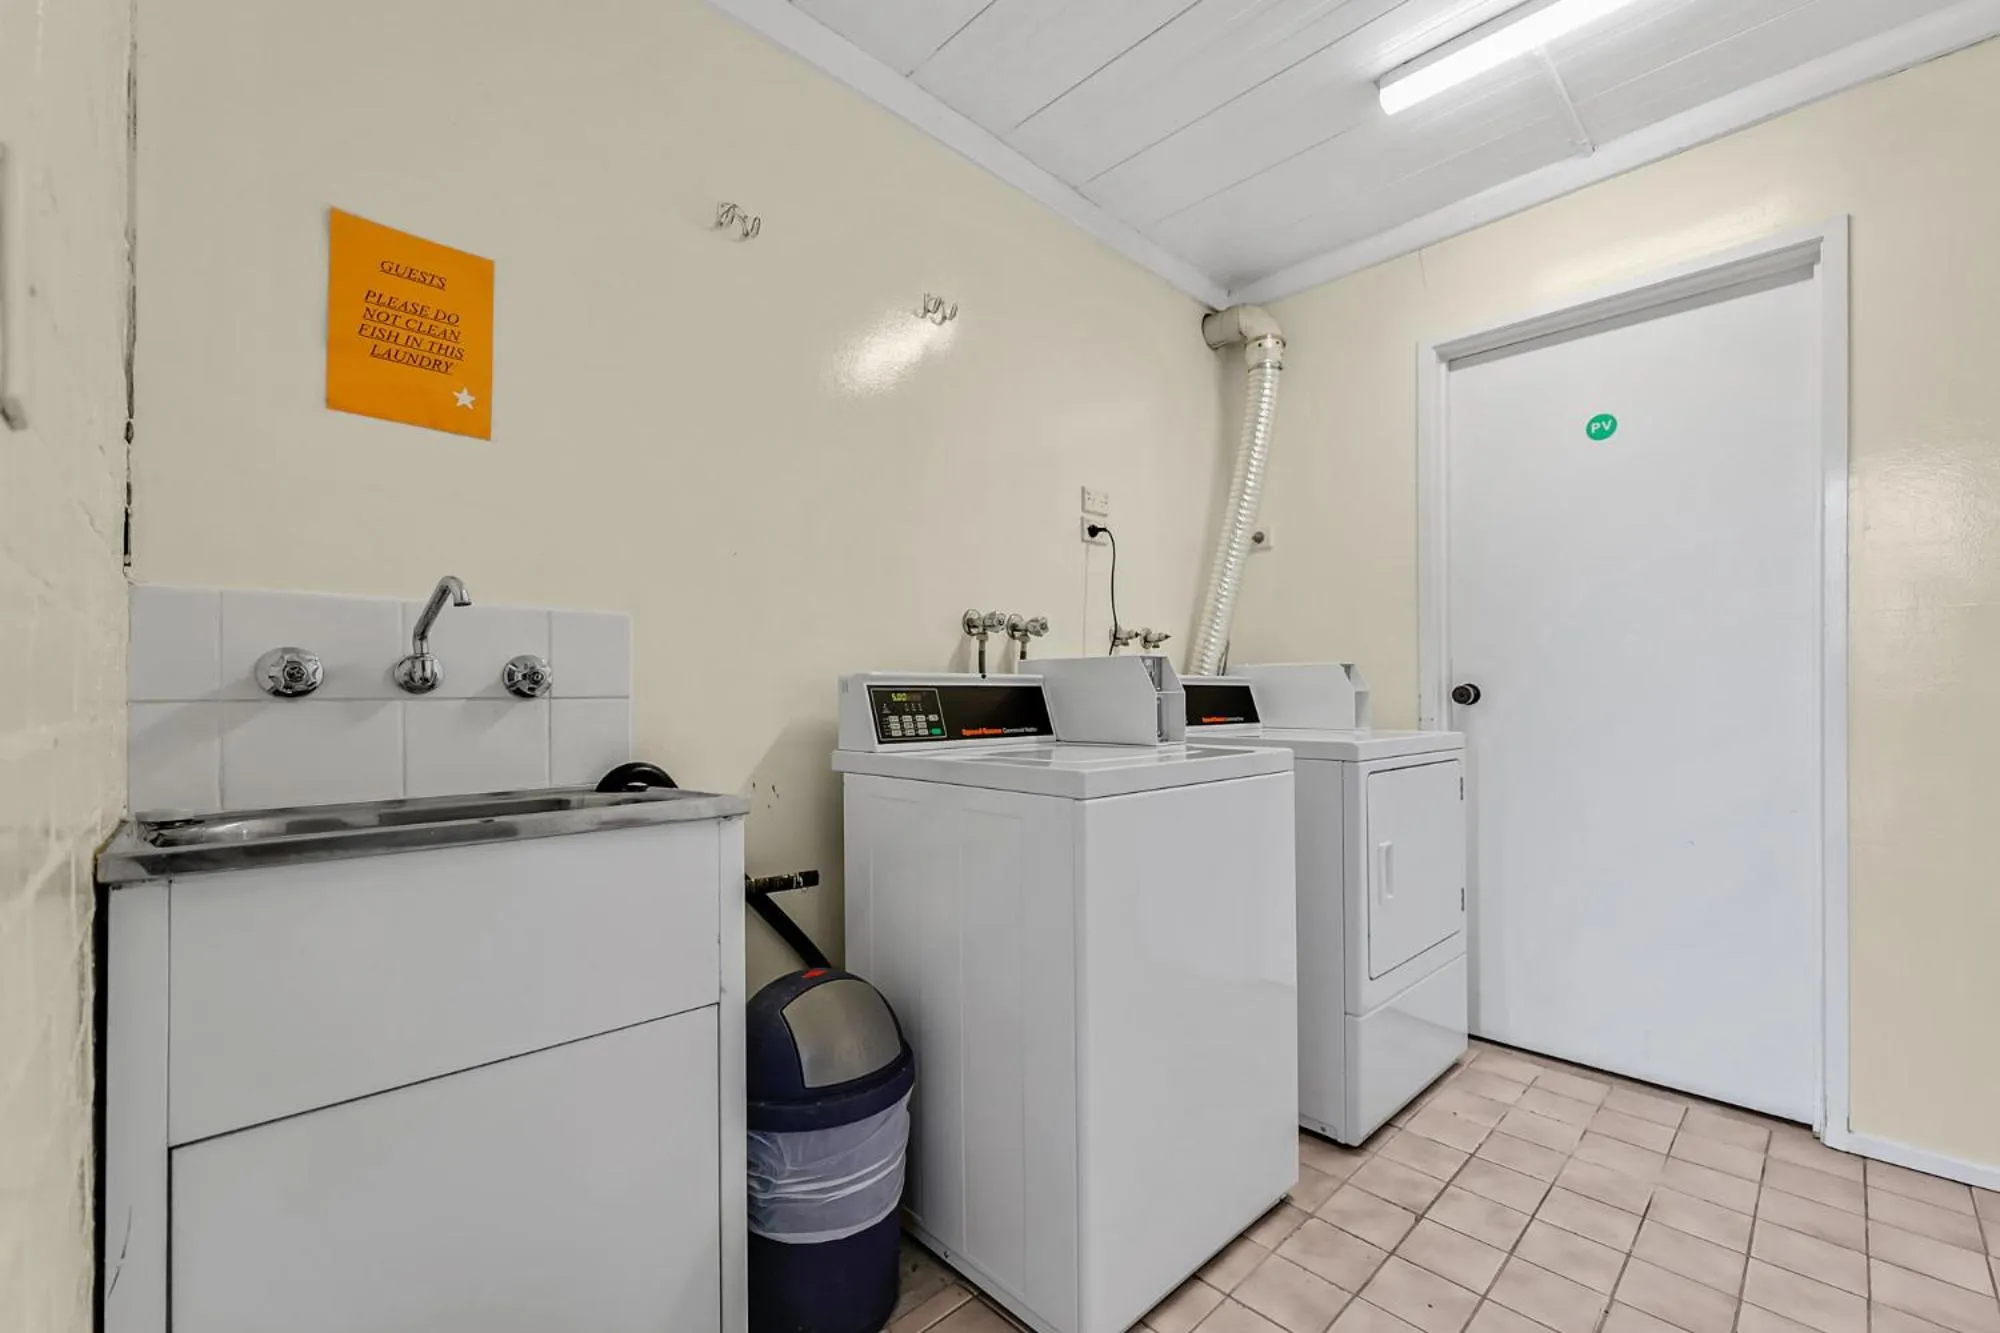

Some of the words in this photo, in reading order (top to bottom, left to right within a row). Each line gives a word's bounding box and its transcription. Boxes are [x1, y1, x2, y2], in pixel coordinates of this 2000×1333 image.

[380, 260, 447, 290] GUESTS
[363, 306, 401, 328] NOT
[405, 318, 461, 343] CLEAN
[364, 289, 431, 317] PLEASE
[434, 308, 460, 326] DO
[359, 323, 400, 343] FISH
[405, 335, 423, 349] IN
[428, 341, 465, 361] THIS
[370, 343, 454, 375] LAUNDRY
[1591, 419, 1612, 434] PV
